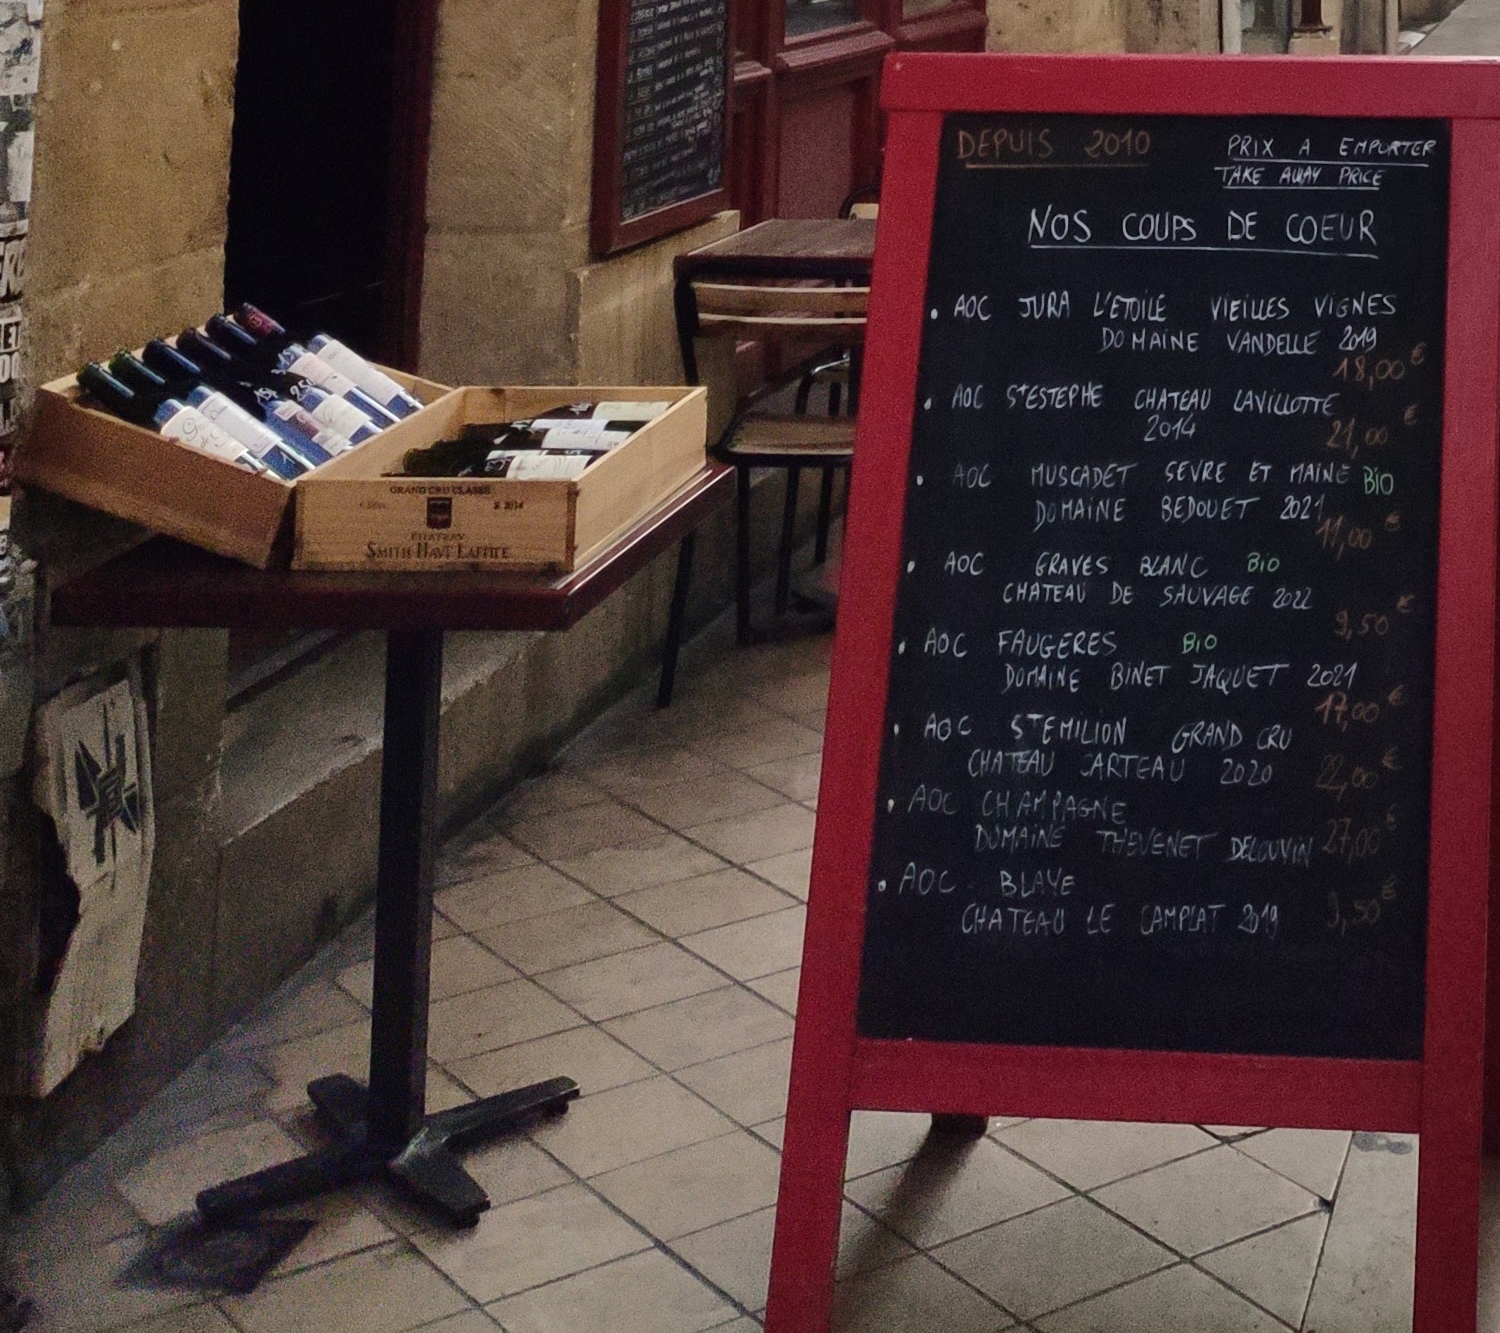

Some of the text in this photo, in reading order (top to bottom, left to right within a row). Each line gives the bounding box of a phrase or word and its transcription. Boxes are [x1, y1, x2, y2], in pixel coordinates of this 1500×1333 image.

[957, 128, 1150, 159] DEPUIS 2010
[1227, 134, 1274, 157] PRIX
[1339, 137, 1437, 157] EMPORTER
[1214, 166, 1387, 186] TAKE AWAY PRICE
[1027, 204, 1377, 247] NOS COUPS DE COEUR
[953, 293, 992, 321] AOC
[1018, 290, 1071, 319] JURA
[1314, 291, 1397, 318] VIGNES
[1226, 329, 1321, 356] VANDELLE
[1338, 325, 1378, 353] 2019
[951, 383, 984, 409] AOC
[1134, 388, 1212, 411] CHATEAU
[1143, 414, 1197, 442] 2014
[952, 462, 991, 489] AOC
[1031, 462, 1139, 490] MUSCADET
[1165, 460, 1229, 484] SEVRE
[1249, 461, 1273, 482] ET
[1034, 493, 1326, 533] DOMAINE BEDOUET 2021
[944, 551, 985, 576] AOC
[1035, 551, 1112, 577] GRAVES
[1140, 553, 1209, 578] BLANC
[1002, 580, 1313, 610] CHATEAU DE SAUVAGE 2022
[924, 627, 968, 658] AOC
[998, 628, 1118, 659] FAUGERES
[1110, 661, 1172, 690] BINET
[1190, 663, 1290, 695] JAQUET
[1307, 662, 1358, 690] 2021
[924, 713, 971, 742] AOC
[1171, 720, 1243, 754] GRAND
[1256, 724, 1292, 750] CRU
[967, 749, 1056, 777] CHATEAU
[1220, 758, 1273, 786] 2020
[907, 784, 1128, 825] AOC CHAMPAGNE
[898, 861, 1075, 898] AOC BLAYE
[961, 903, 1065, 936] CHATEAU
[1087, 904, 1116, 935] LE
